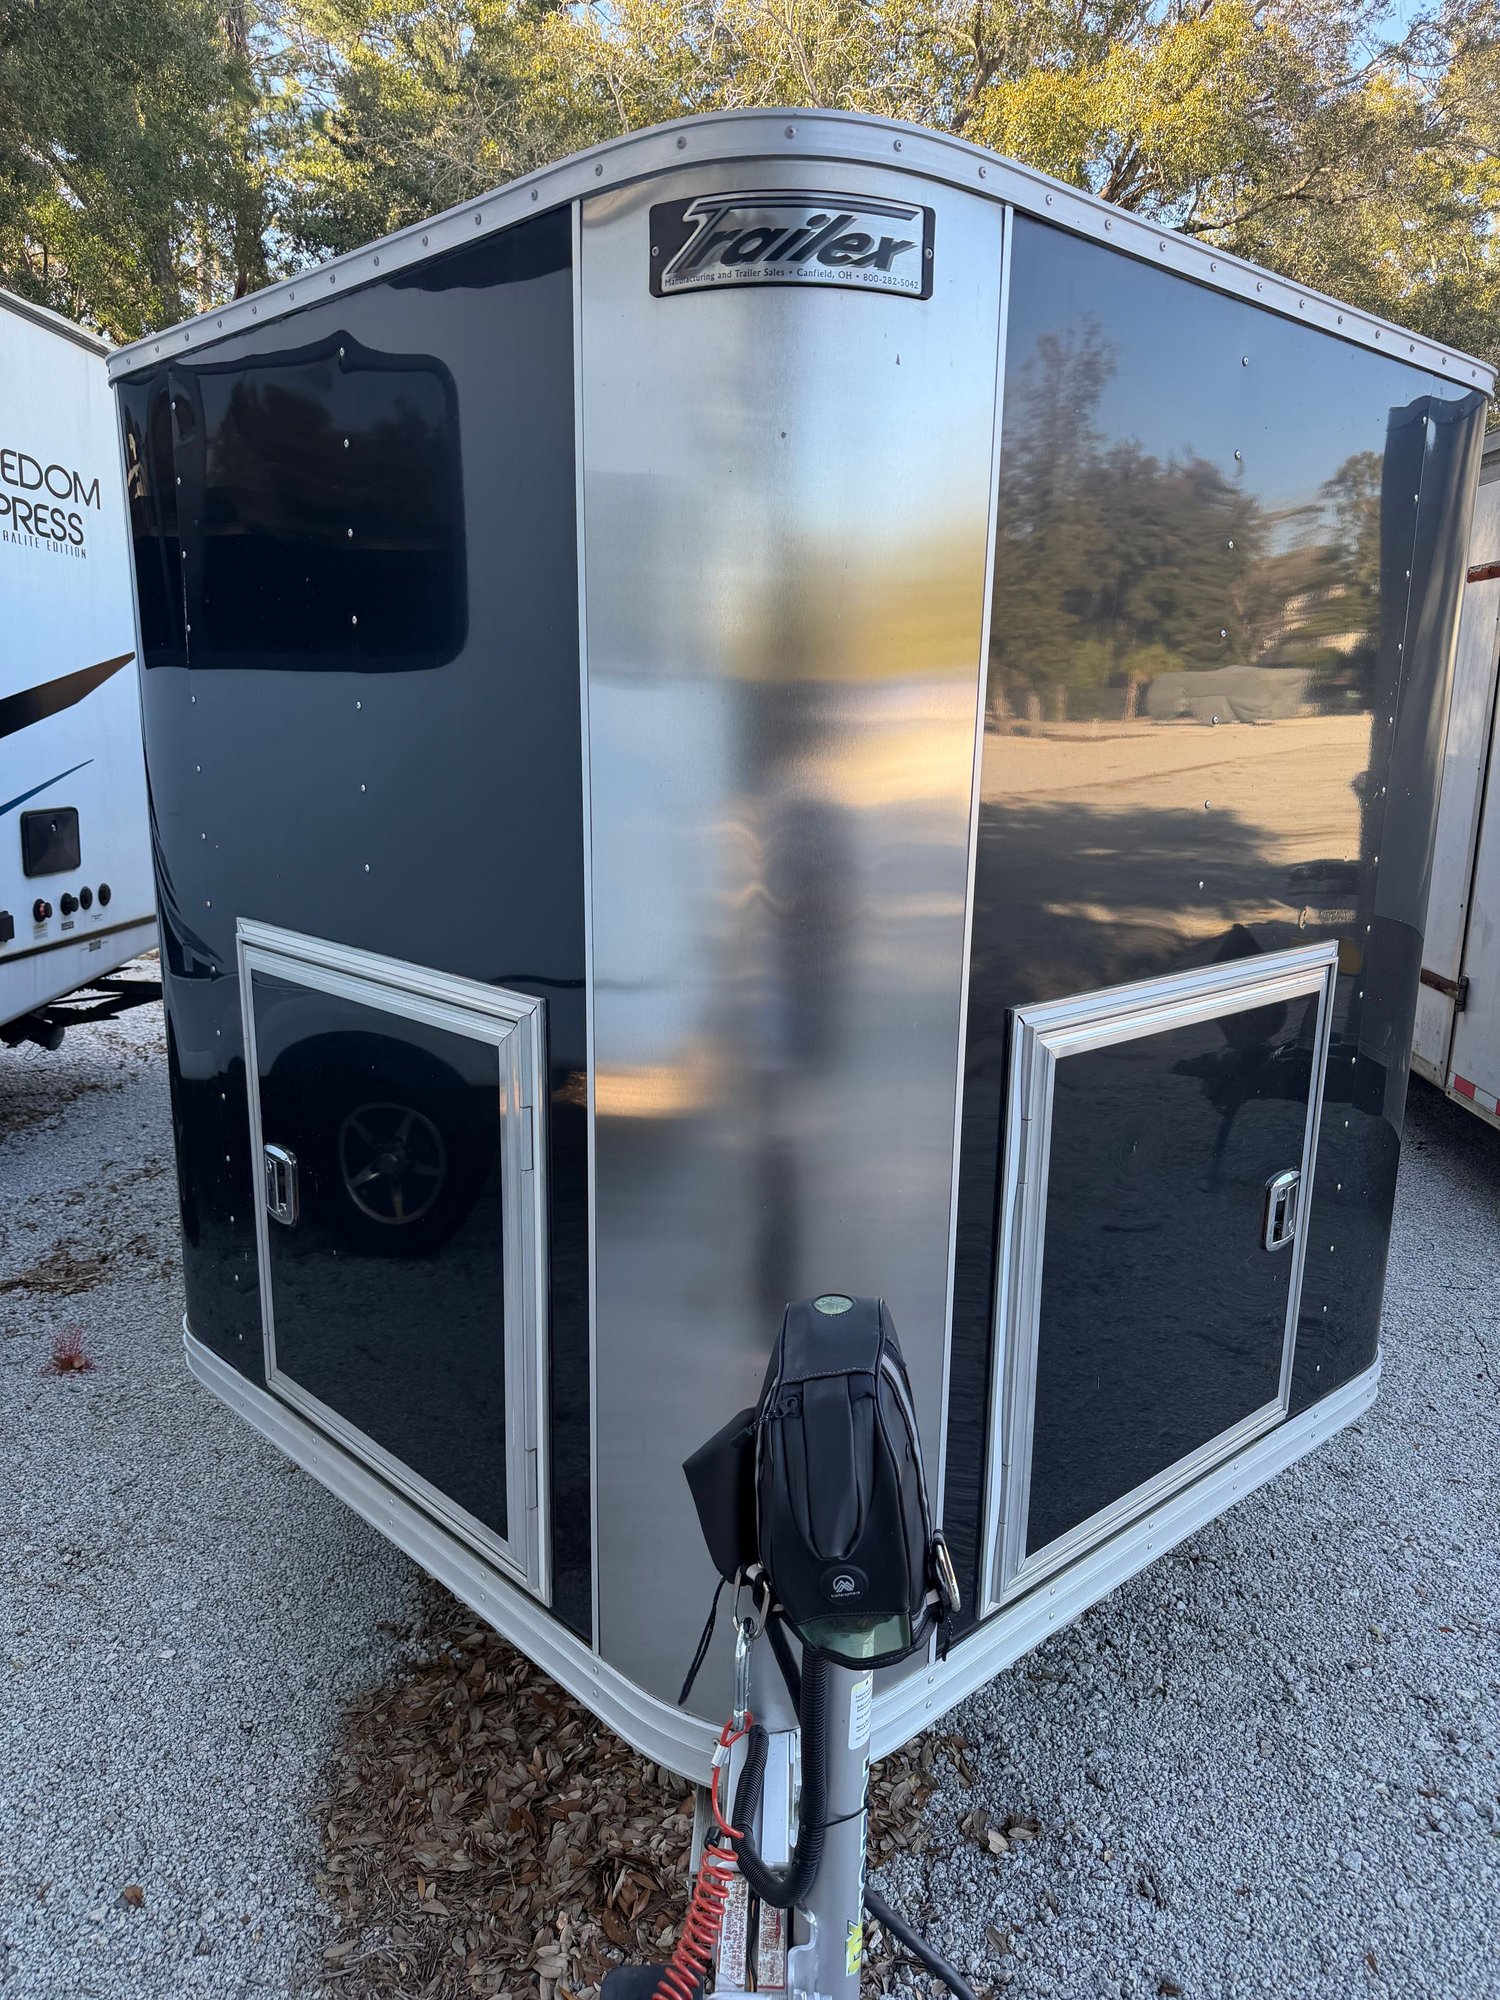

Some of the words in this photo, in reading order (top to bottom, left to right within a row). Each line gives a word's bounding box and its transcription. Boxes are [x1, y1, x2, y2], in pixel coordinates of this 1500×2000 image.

[664, 196, 921, 276] Trailex
[665, 273, 715, 287] Manufacturing
[717, 270, 732, 279] and
[735, 268, 761, 278] Trailer
[764, 268, 785, 277] Sales
[796, 268, 835, 279] Canfield,
[838, 270, 852, 280] OH
[863, 273, 919, 290] 800-282-5042
[3, 530, 40, 549] RALITE
[46, 540, 87, 559] EDITION
